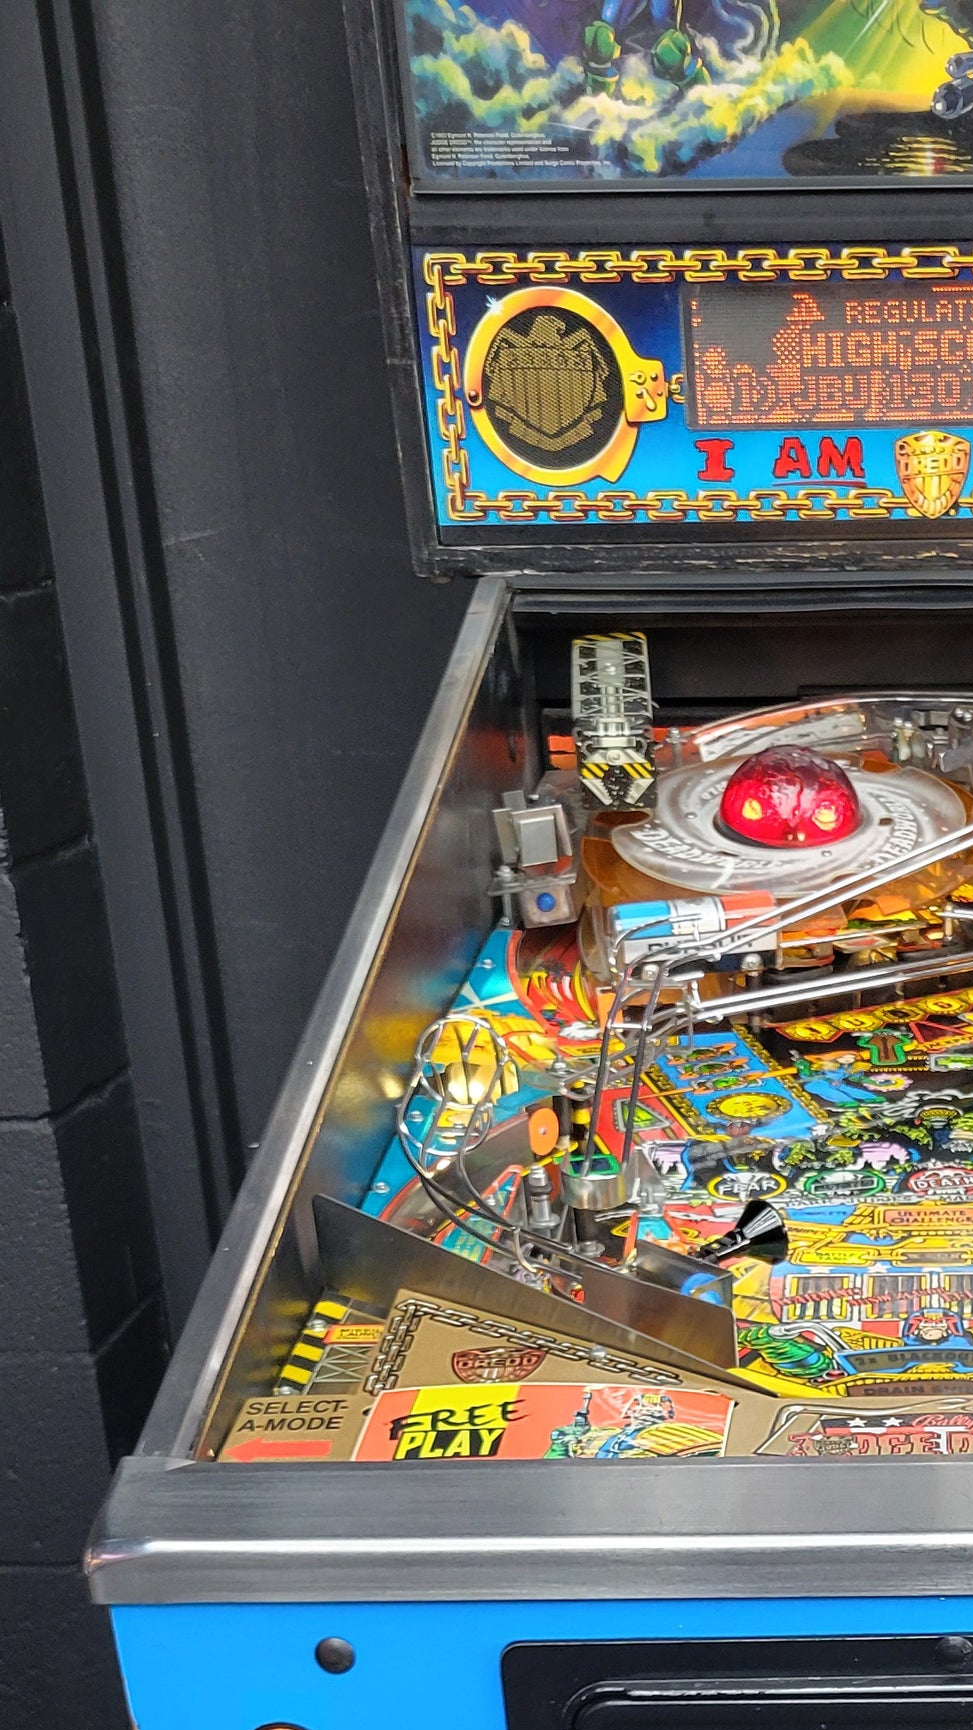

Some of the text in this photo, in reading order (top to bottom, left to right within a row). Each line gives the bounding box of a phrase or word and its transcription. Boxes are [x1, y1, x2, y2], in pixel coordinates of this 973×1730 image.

[801, 328, 901, 367] HIGH
[695, 436, 867, 481] I AM
[900, 455, 965, 475] DREDD
[718, 1179, 777, 1196] FEAR
[891, 1216, 973, 1224] CHALLENGE
[456, 1356, 541, 1369] DREDD
[864, 1386, 925, 1396] DRAIN
[246, 1400, 349, 1416] SELECT-
[237, 1415, 345, 1433] A-MODE
[389, 1398, 530, 1440] FREE
[394, 1428, 505, 1460] PLAY
